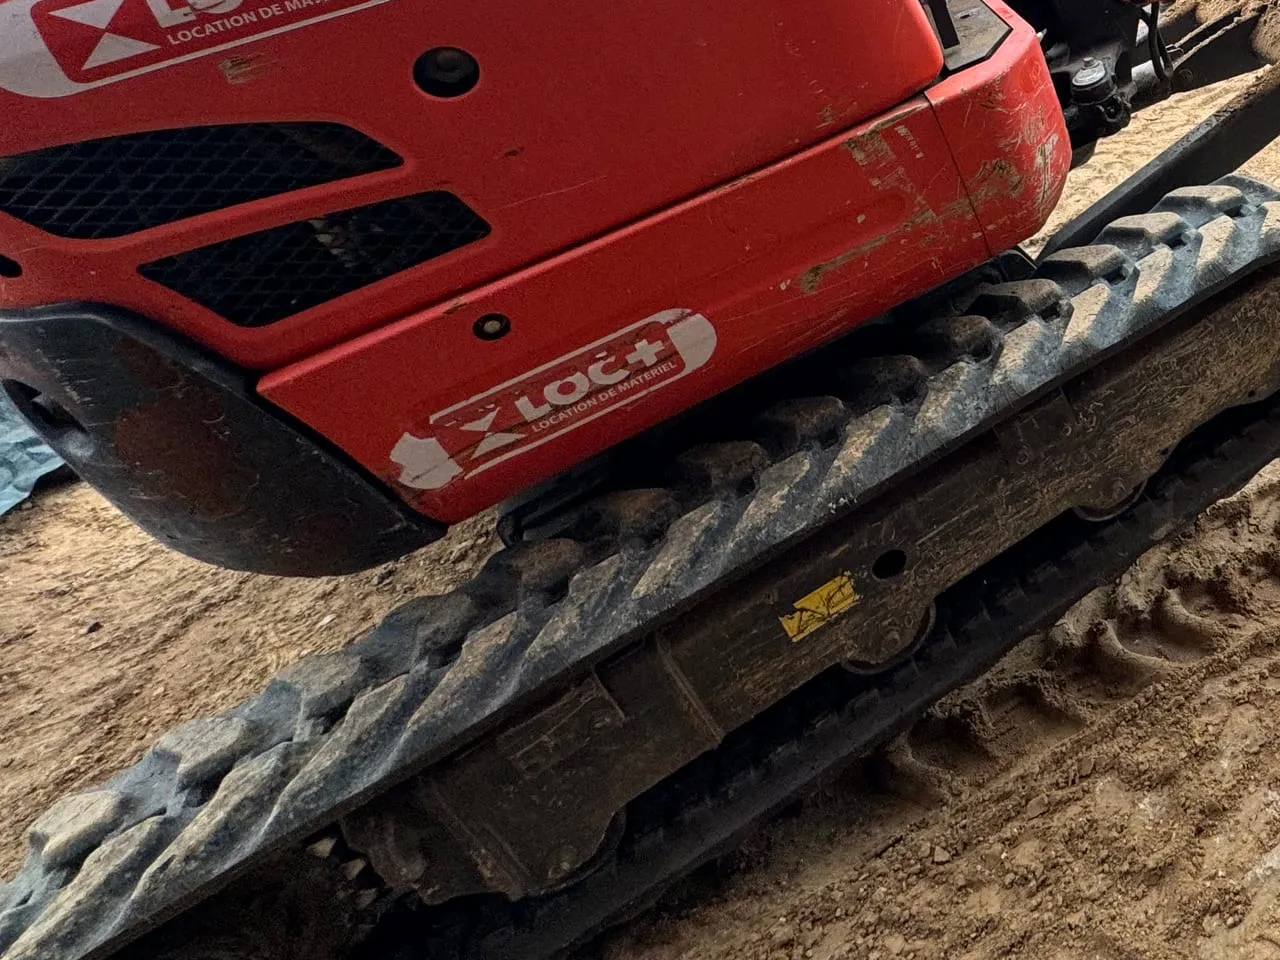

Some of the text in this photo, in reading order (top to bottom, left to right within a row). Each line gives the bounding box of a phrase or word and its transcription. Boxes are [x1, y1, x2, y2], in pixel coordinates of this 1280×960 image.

[167, 11, 258, 45] LOCATION
[258, 3, 284, 20] DE
[513, 338, 665, 423] LOC+
[531, 361, 677, 432] LOCATION DE MATERIEL
